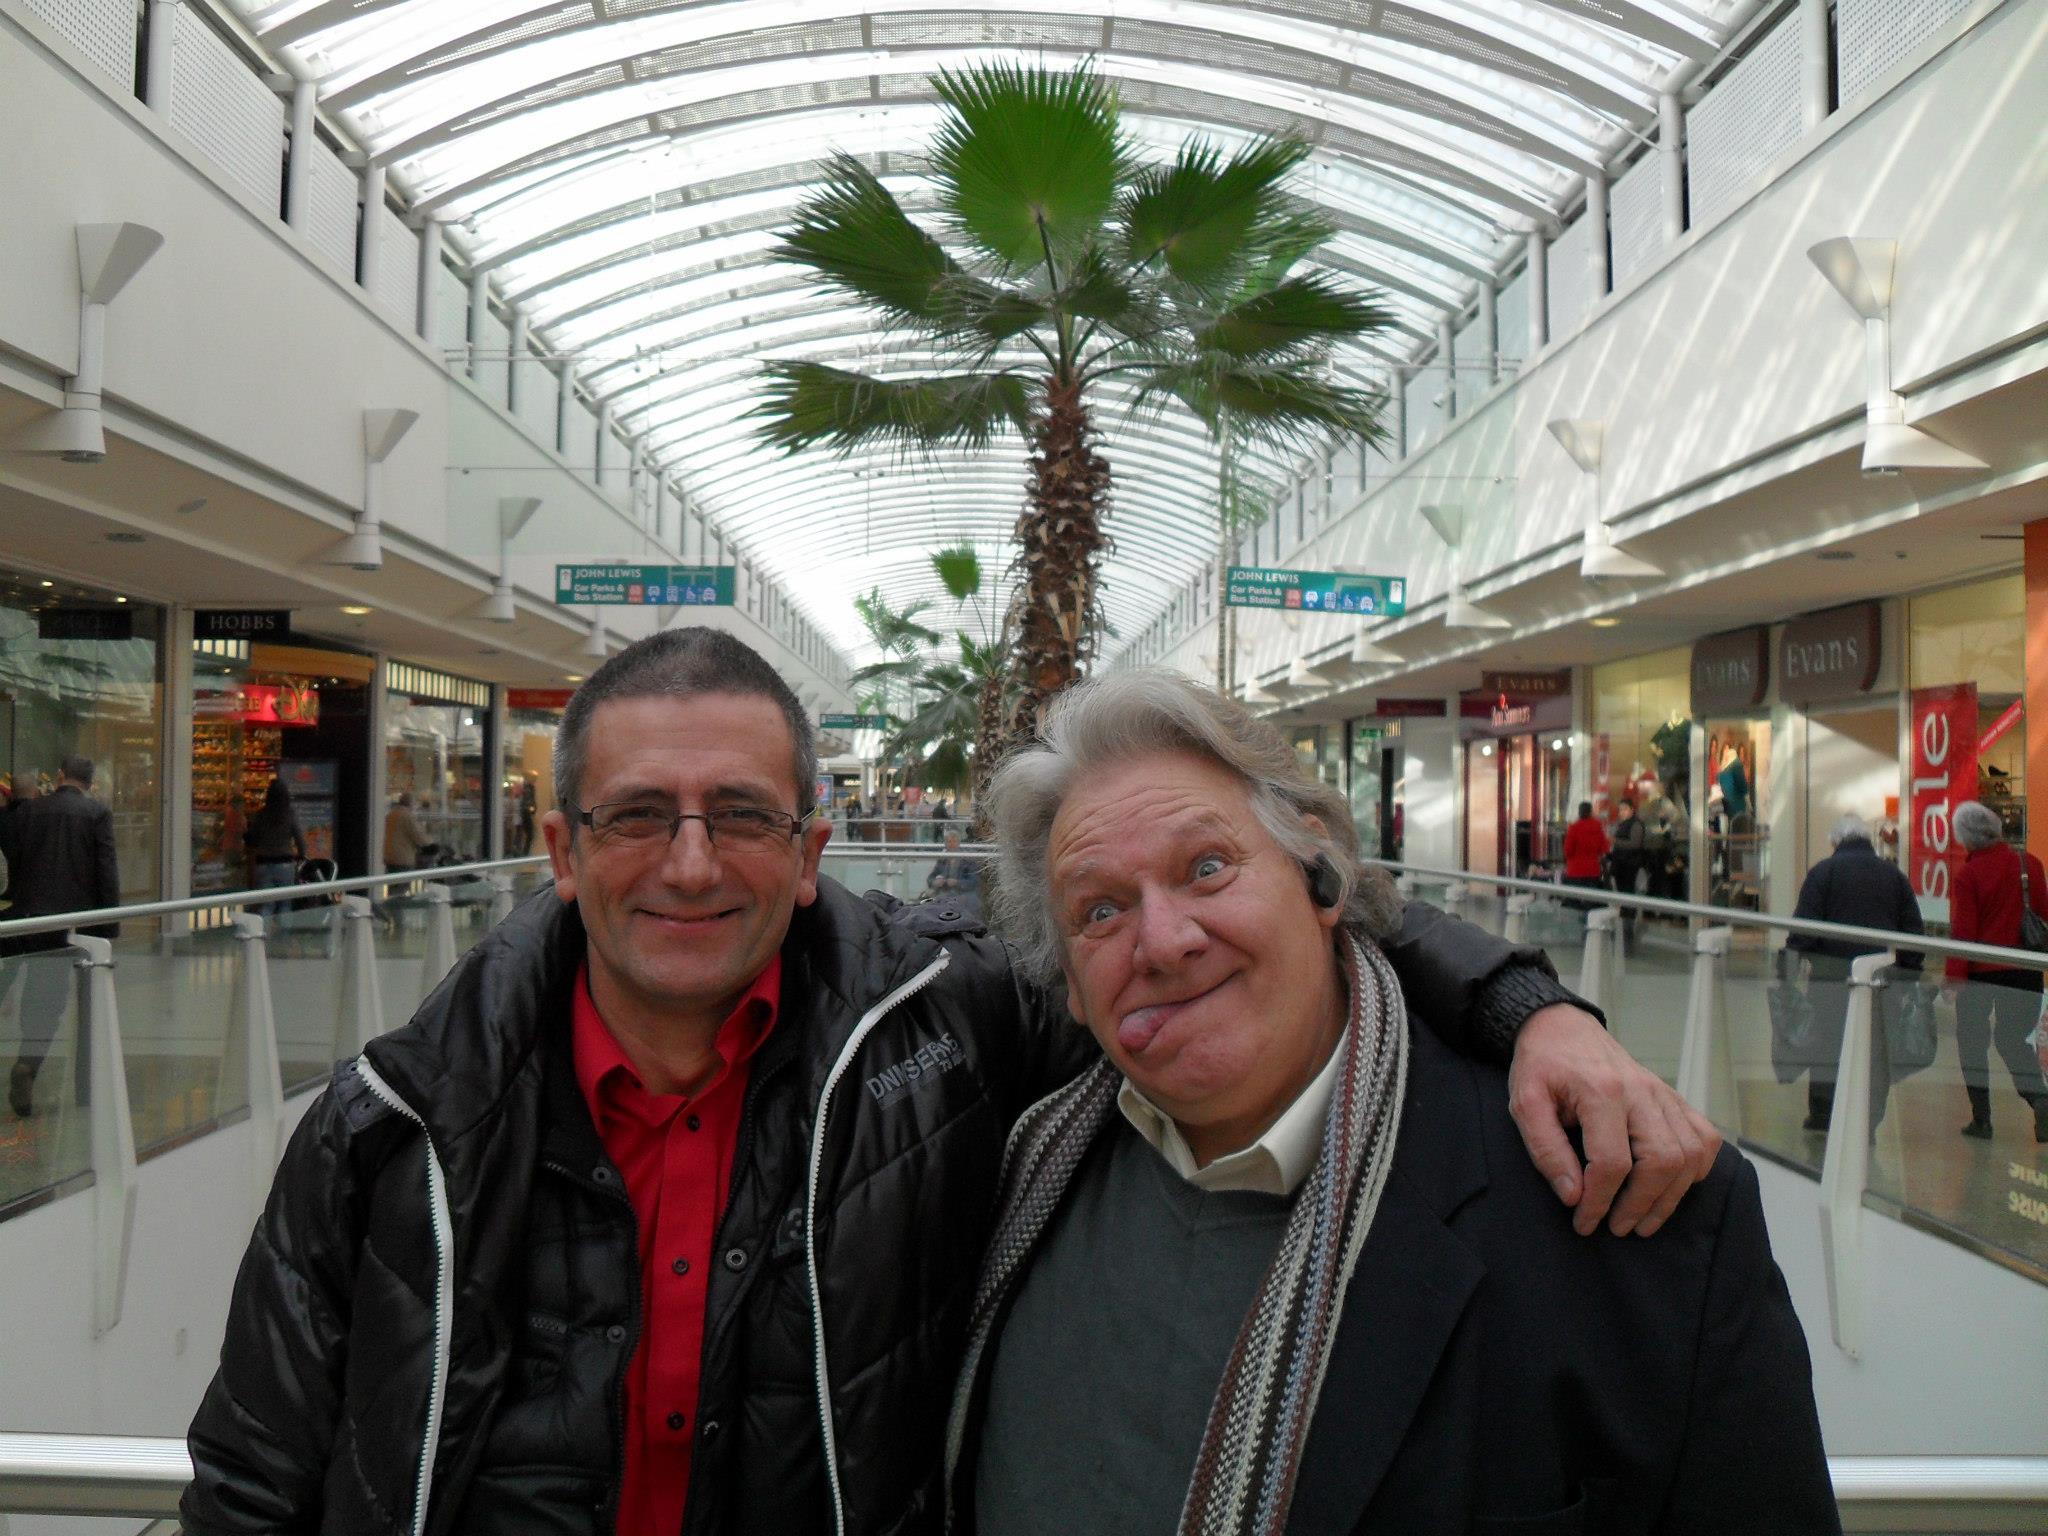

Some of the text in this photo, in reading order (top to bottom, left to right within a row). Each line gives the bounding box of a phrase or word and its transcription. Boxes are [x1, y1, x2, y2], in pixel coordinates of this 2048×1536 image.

[575, 568, 641, 579] JOHN LEWIS
[1232, 571, 1299, 583] JOHN LEWIS
[574, 584, 624, 592] Car Parks &
[1231, 585, 1281, 596] Car Parks &
[574, 593, 623, 601] Bus Station
[1231, 594, 1281, 604] Bus Station
[210, 615, 275, 630] HOBBS
[1786, 635, 1858, 678] Evans
[1913, 711, 1949, 898] sale
